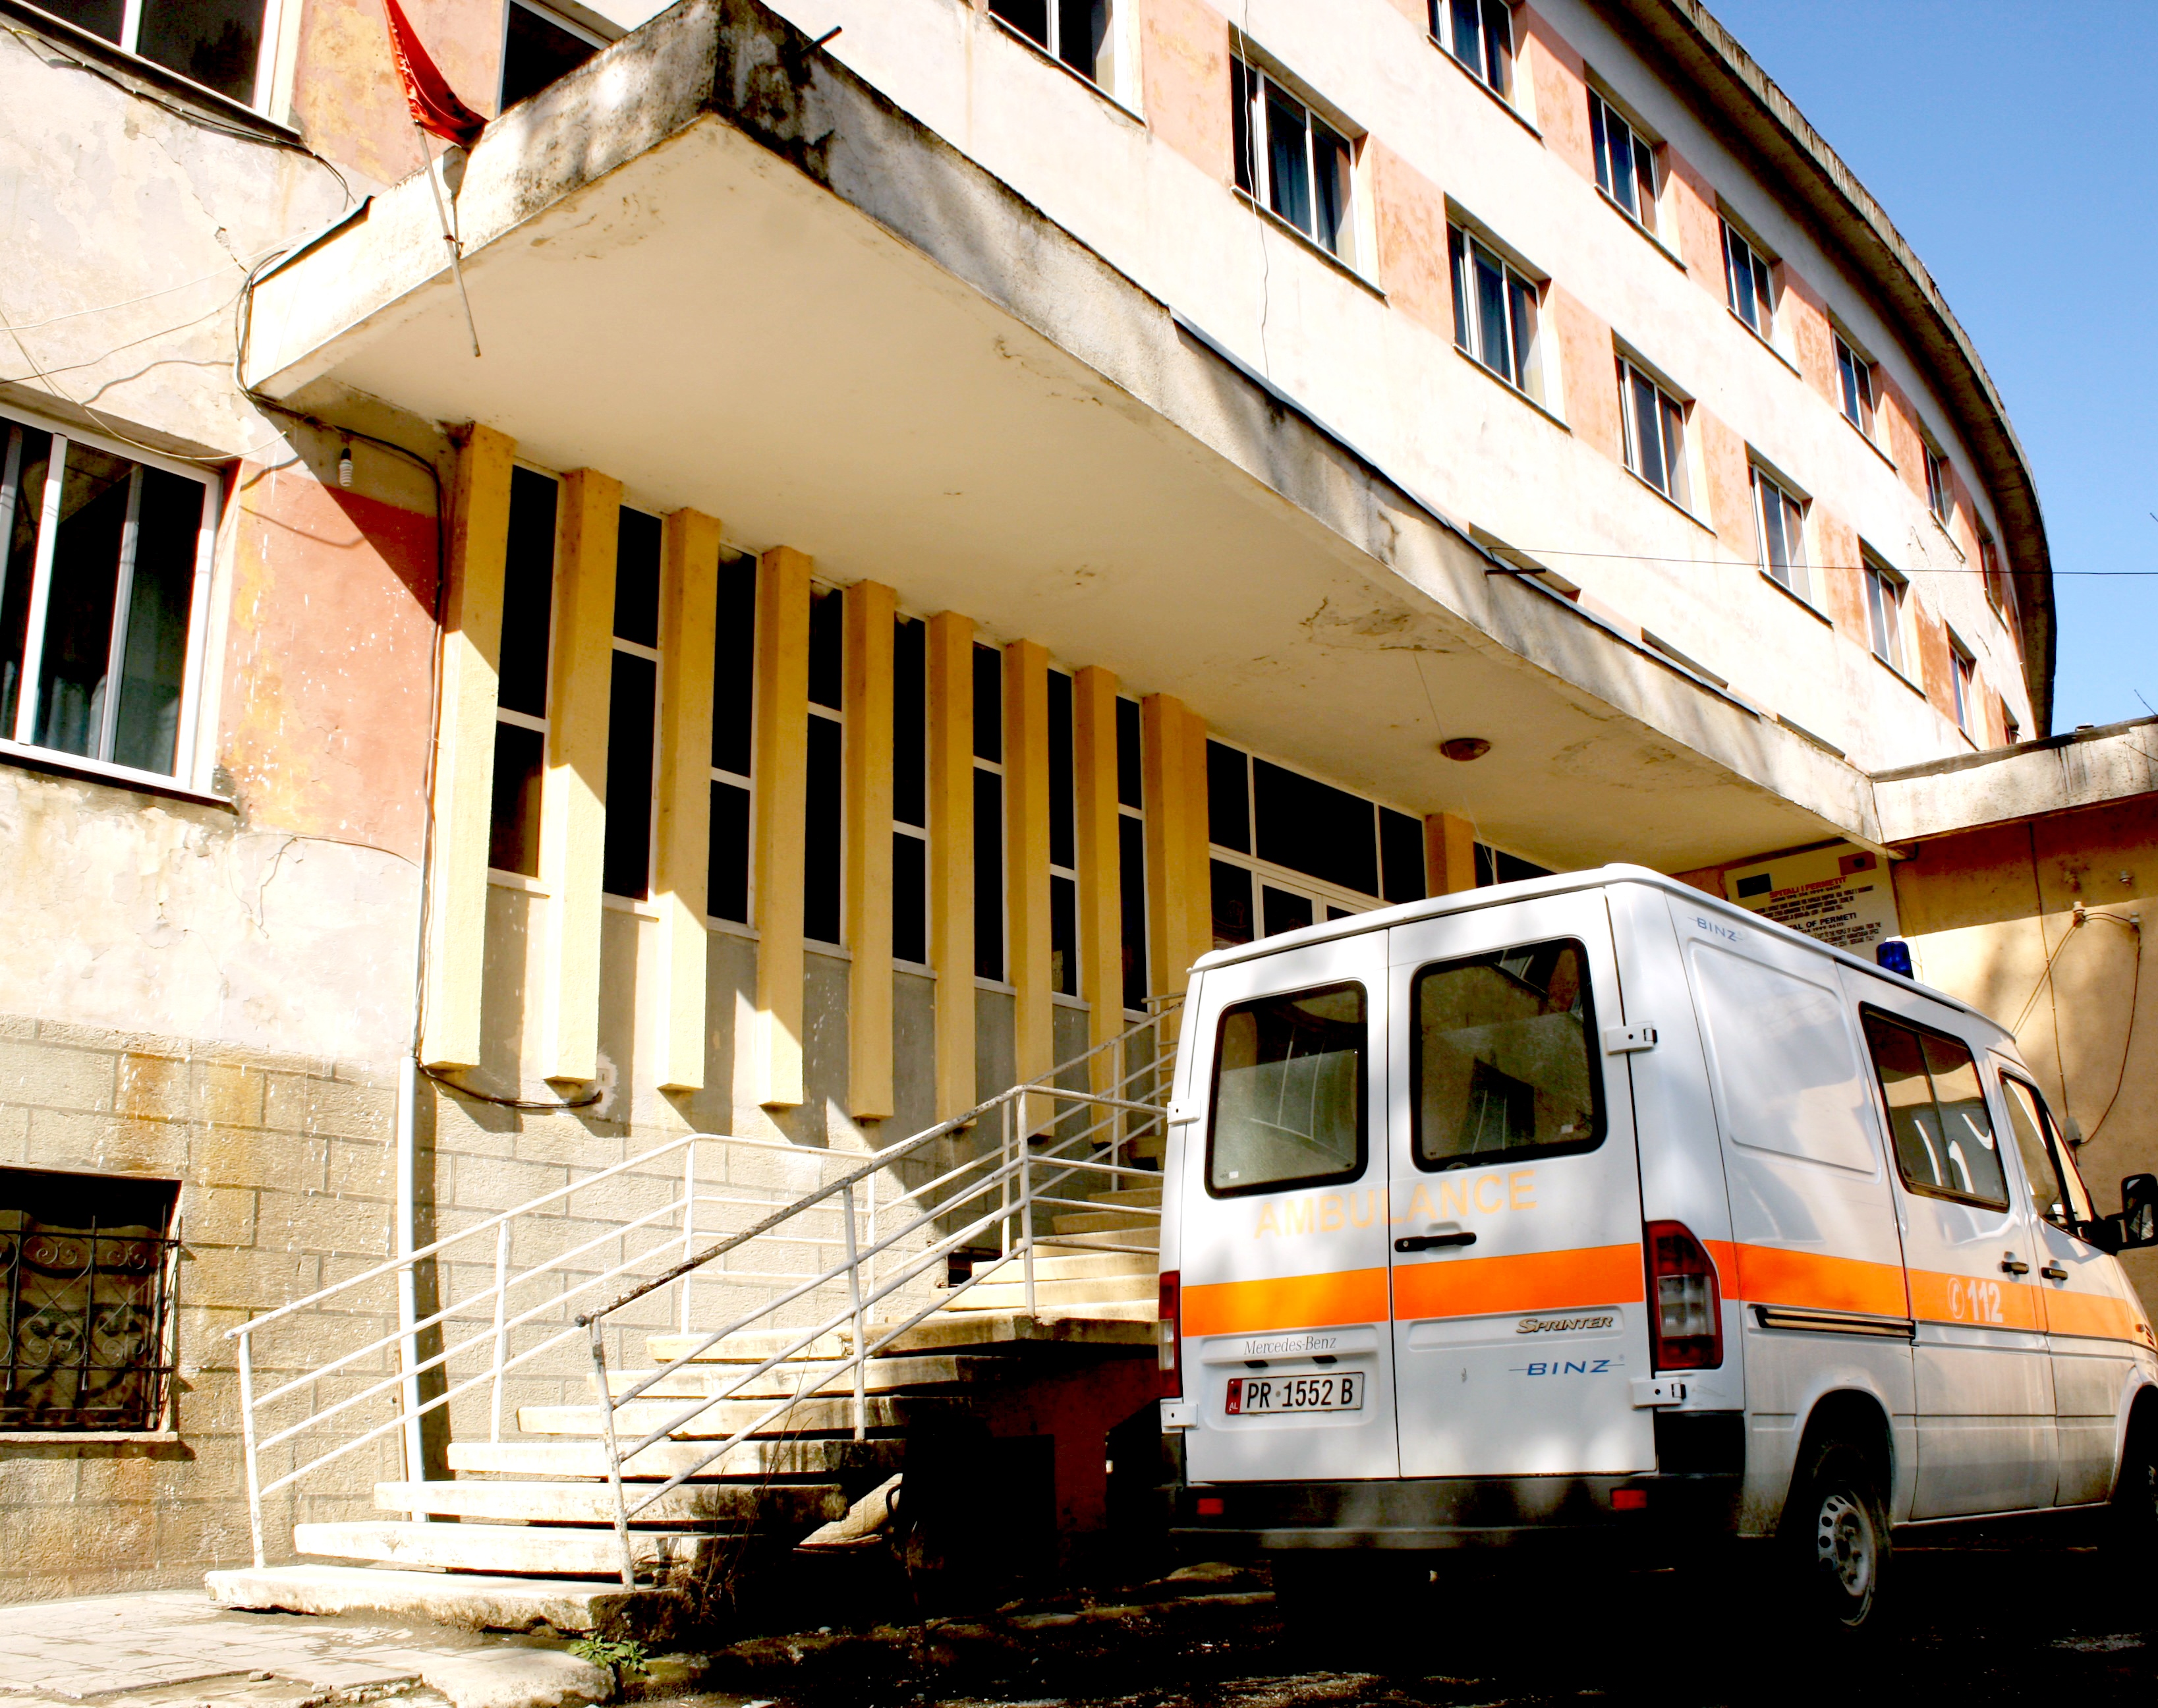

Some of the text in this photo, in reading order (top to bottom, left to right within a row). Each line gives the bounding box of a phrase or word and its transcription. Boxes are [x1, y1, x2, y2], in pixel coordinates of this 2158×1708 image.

[1697, 917, 1736, 942] BINZ
[1820, 912, 1857, 925] PERMETI
[1254, 1170, 1537, 1239] AMBULANCE
[1968, 1280, 2003, 1323] 112
[1244, 1336, 1336, 1355] Mercedes-Benz
[1527, 1360, 1610, 1376] BINZ
[1247, 1378, 1353, 1408] PR 1552 B
